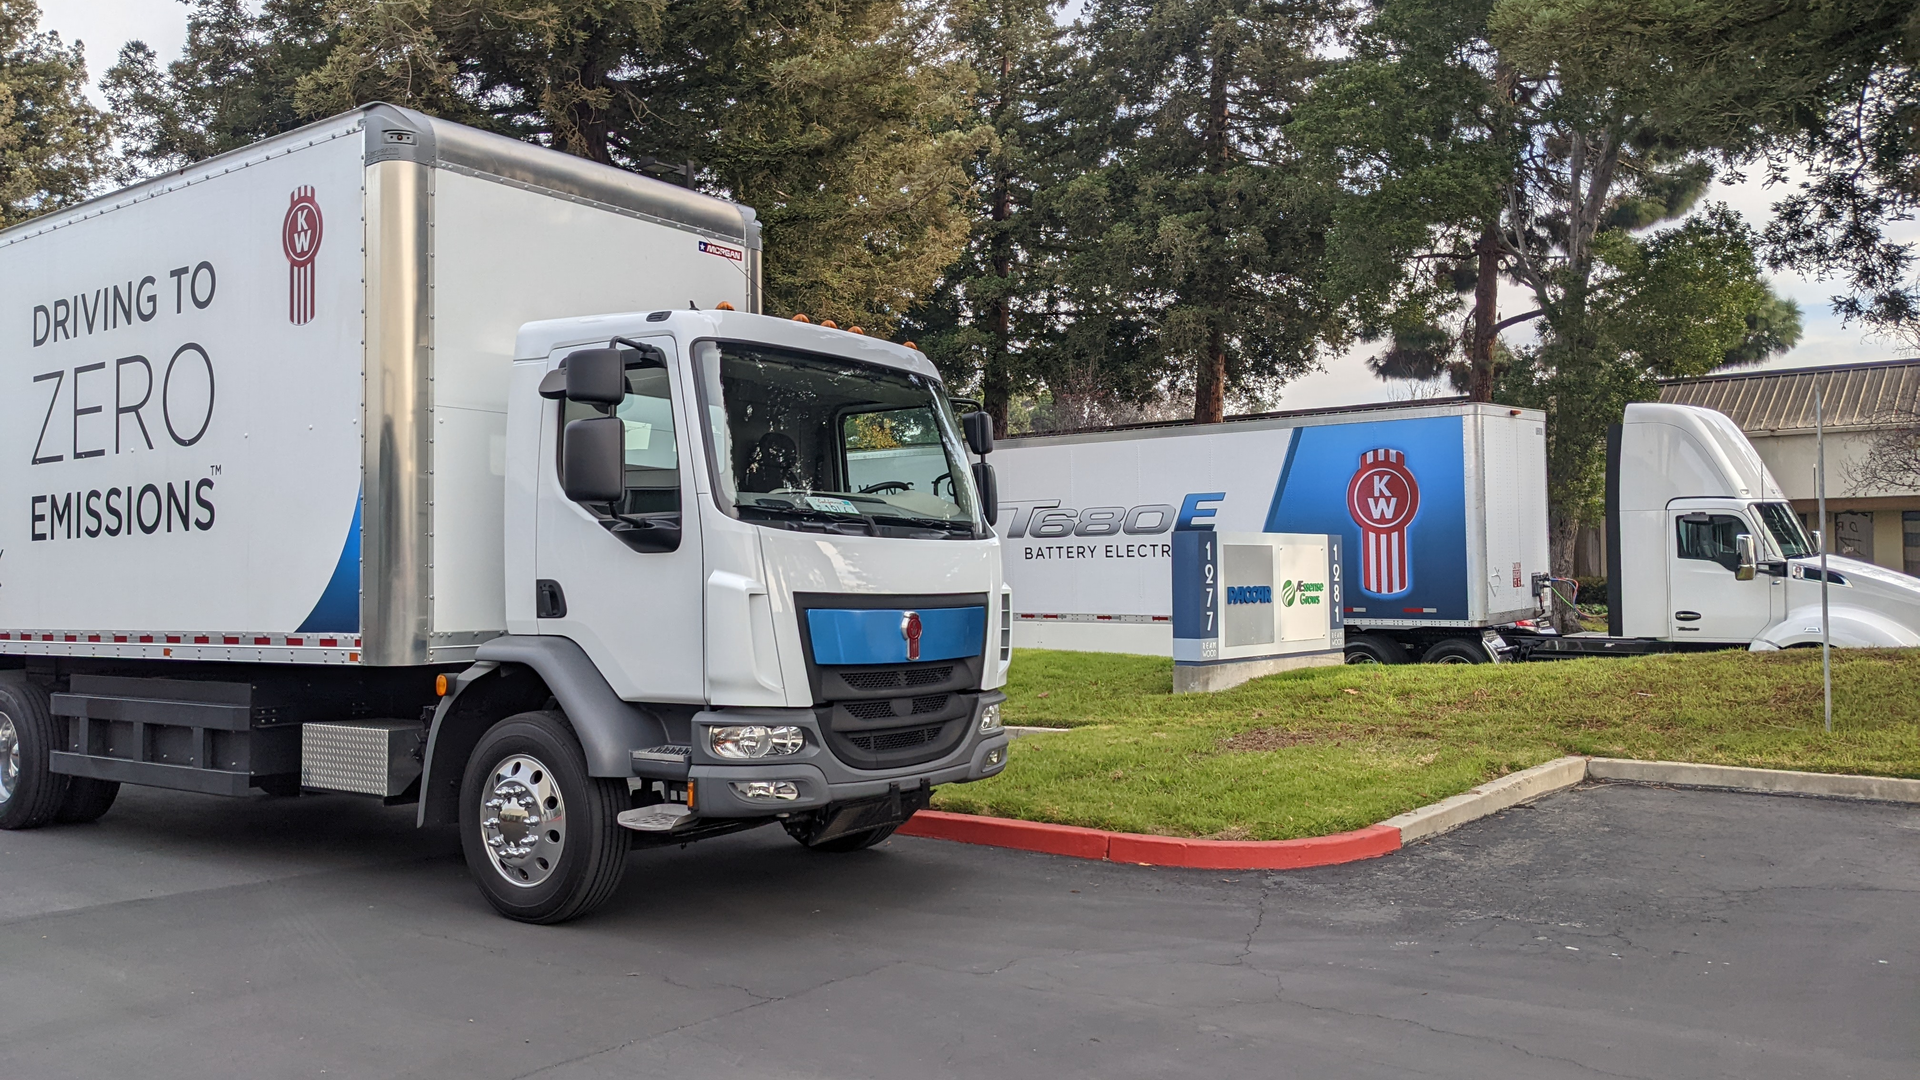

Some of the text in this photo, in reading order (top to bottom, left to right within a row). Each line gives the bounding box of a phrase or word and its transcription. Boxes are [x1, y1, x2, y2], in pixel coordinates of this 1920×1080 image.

[706, 244, 741, 260] MORGAN
[33, 260, 216, 348] DRIVING TO
[31, 342, 215, 466] ZERO
[31, 477, 216, 542] EMISSIONS
[1024, 544, 1171, 560] BATTERY ELECTR
[1227, 585, 1272, 606] PACCAR
[1300, 593, 1320, 605] Grows
